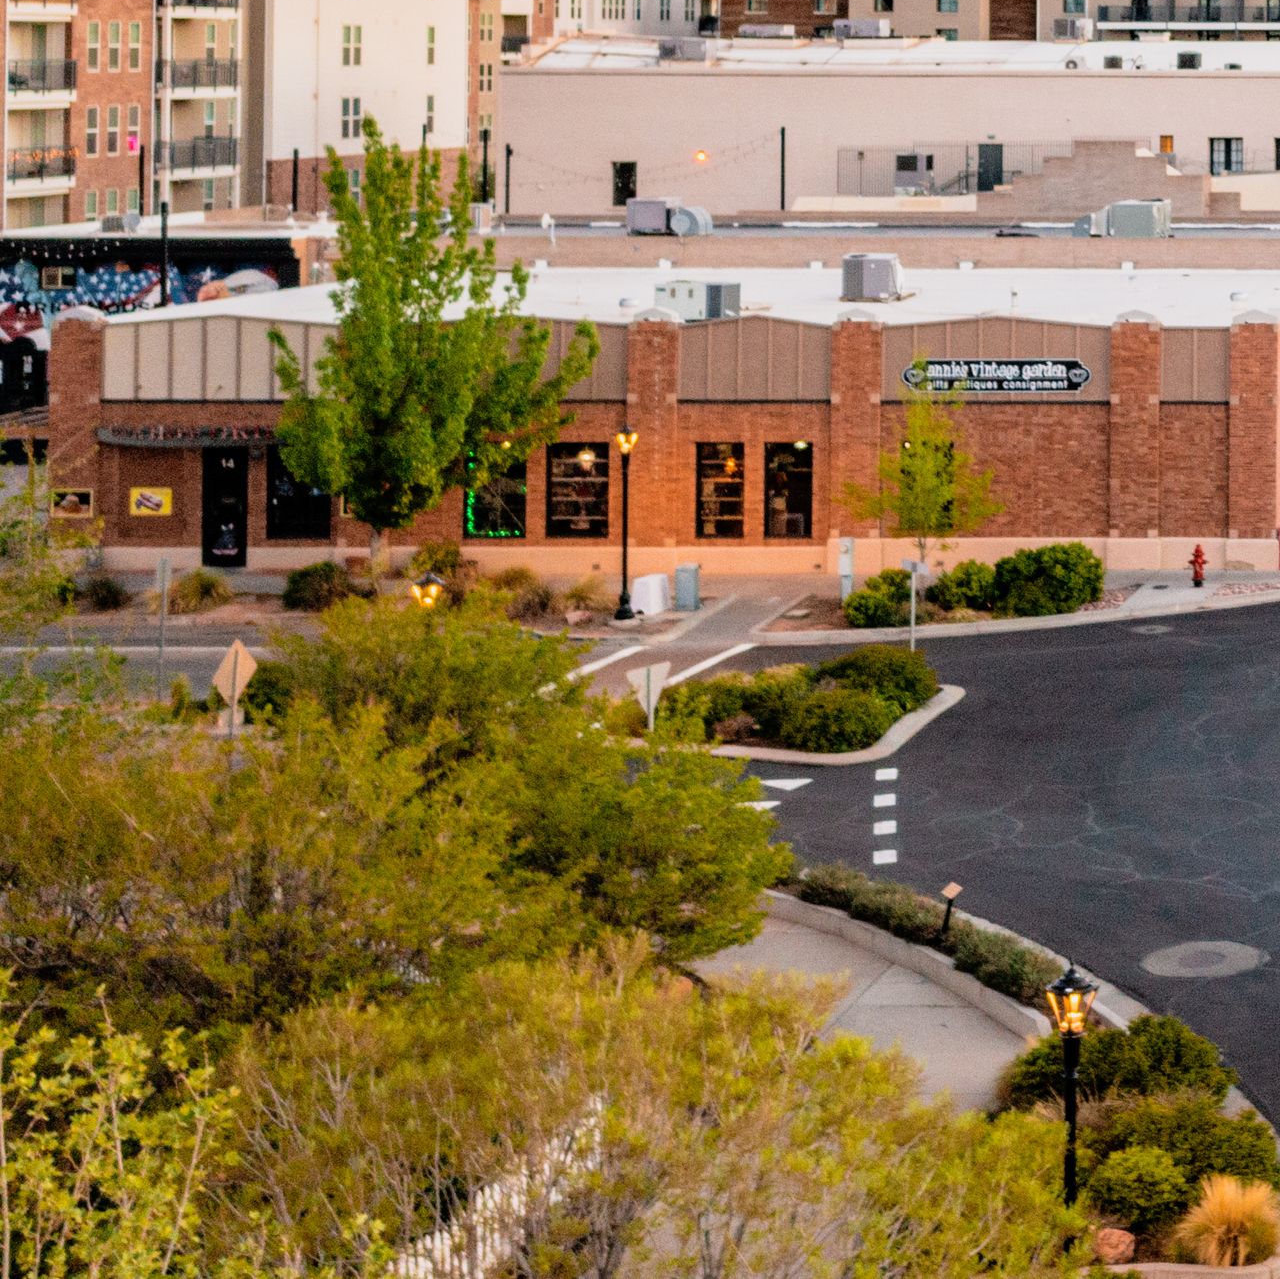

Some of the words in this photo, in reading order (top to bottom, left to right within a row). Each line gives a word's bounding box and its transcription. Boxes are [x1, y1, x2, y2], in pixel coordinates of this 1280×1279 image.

[927, 360, 968, 378] annie's
[970, 361, 1020, 379] vintage
[1022, 360, 1068, 379] garden
[1002, 379, 1068, 390] consignment
[221, 457, 235, 468] 14
